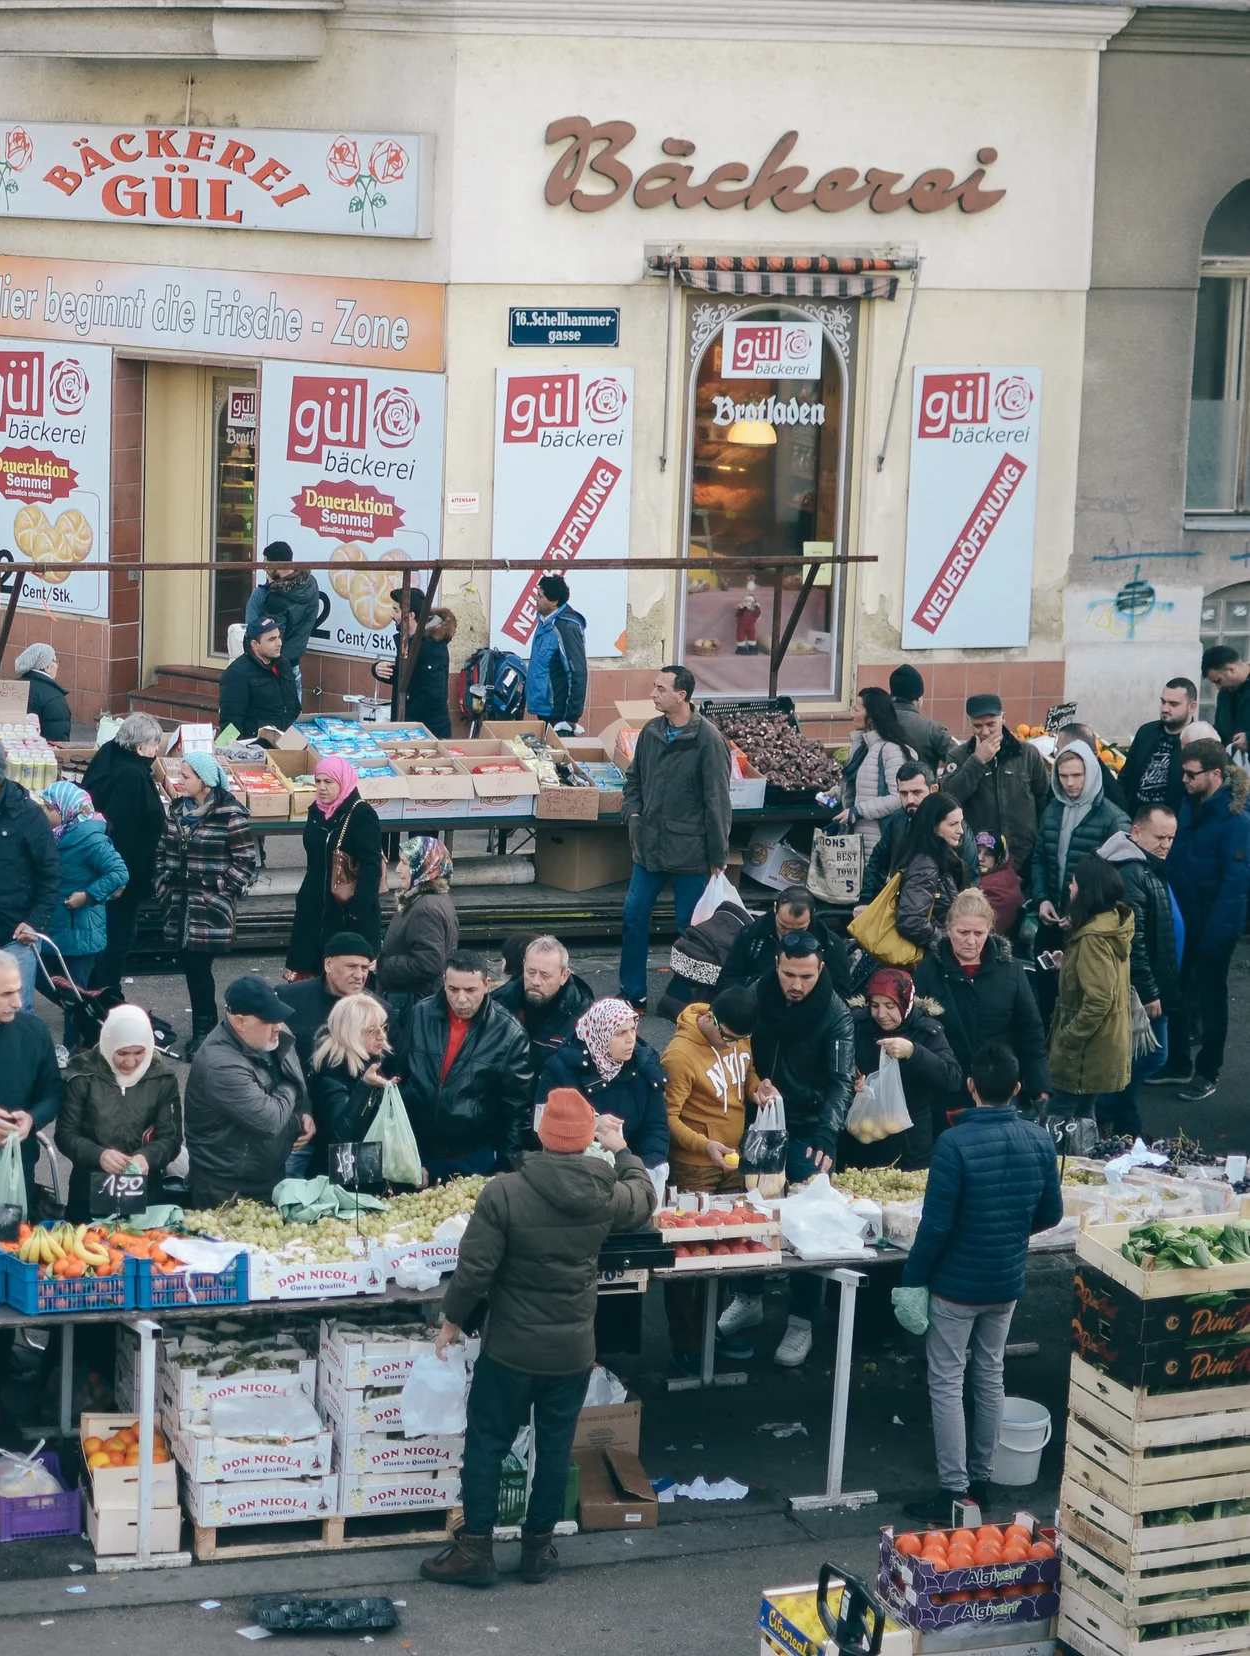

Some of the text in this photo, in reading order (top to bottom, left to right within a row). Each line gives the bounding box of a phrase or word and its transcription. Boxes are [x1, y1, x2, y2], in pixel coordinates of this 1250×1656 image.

[42, 128, 312, 209] BÄCKEREI
[544, 115, 1008, 214] Bäckerei
[101, 164, 244, 224] GÜL
[44, 277, 146, 337] beginnt
[152, 284, 194, 334] die
[203, 290, 302, 343] Frische
[331, 299, 409, 351] Zone
[548, 329, 581, 344] gasse
[736, 328, 779, 368] gül
[754, 362, 810, 376] bäckerei
[232, 394, 254, 417] gül
[511, 377, 574, 438] gül
[711, 395, 826, 427] Brotladen
[924, 376, 986, 434] gül
[293, 384, 362, 455] gül
[8, 418, 87, 445] bäckerei
[540, 430, 624, 448] bäckerei
[951, 427, 1031, 444] bäckerei
[324, 449, 416, 481] bäckerei
[6, 473, 52, 491] Semmel
[305, 488, 394, 517] Daueraktion
[321, 508, 374, 529] Semmel
[318, 524, 375, 539] stündlich ofenfrisch
[922, 463, 1022, 627] NEUERÖFFNUNG
[22, 584, 74, 603] Cent/Stk.
[336, 628, 396, 651] Cent/Stk.
[837, 851, 858, 861] BEST
[836, 868, 858, 877] TOWN
[846, 881, 855, 893] 5
[705, 1052, 751, 1098] NYC
[421, 1247, 459, 1258] NICOL
[277, 1269, 358, 1288] DON NICOLA
[290, 1284, 312, 1292] Gusto
[372, 1361, 400, 1377] DON
[208, 1386, 236, 1400] DON
[374, 1408, 401, 1423] DON
[221, 1455, 302, 1472] DON NICOLA
[371, 1447, 450, 1465] DON NICOLA
[368, 1487, 447, 1505] DON NICOLA
[227, 1498, 308, 1517] DON NICOLA
[240, 1510, 261, 1518] Gusto
[965, 1566, 1026, 1586] Algivert
[961, 1601, 1022, 1621] Algivert
[768, 1608, 809, 1656] Citroreal
